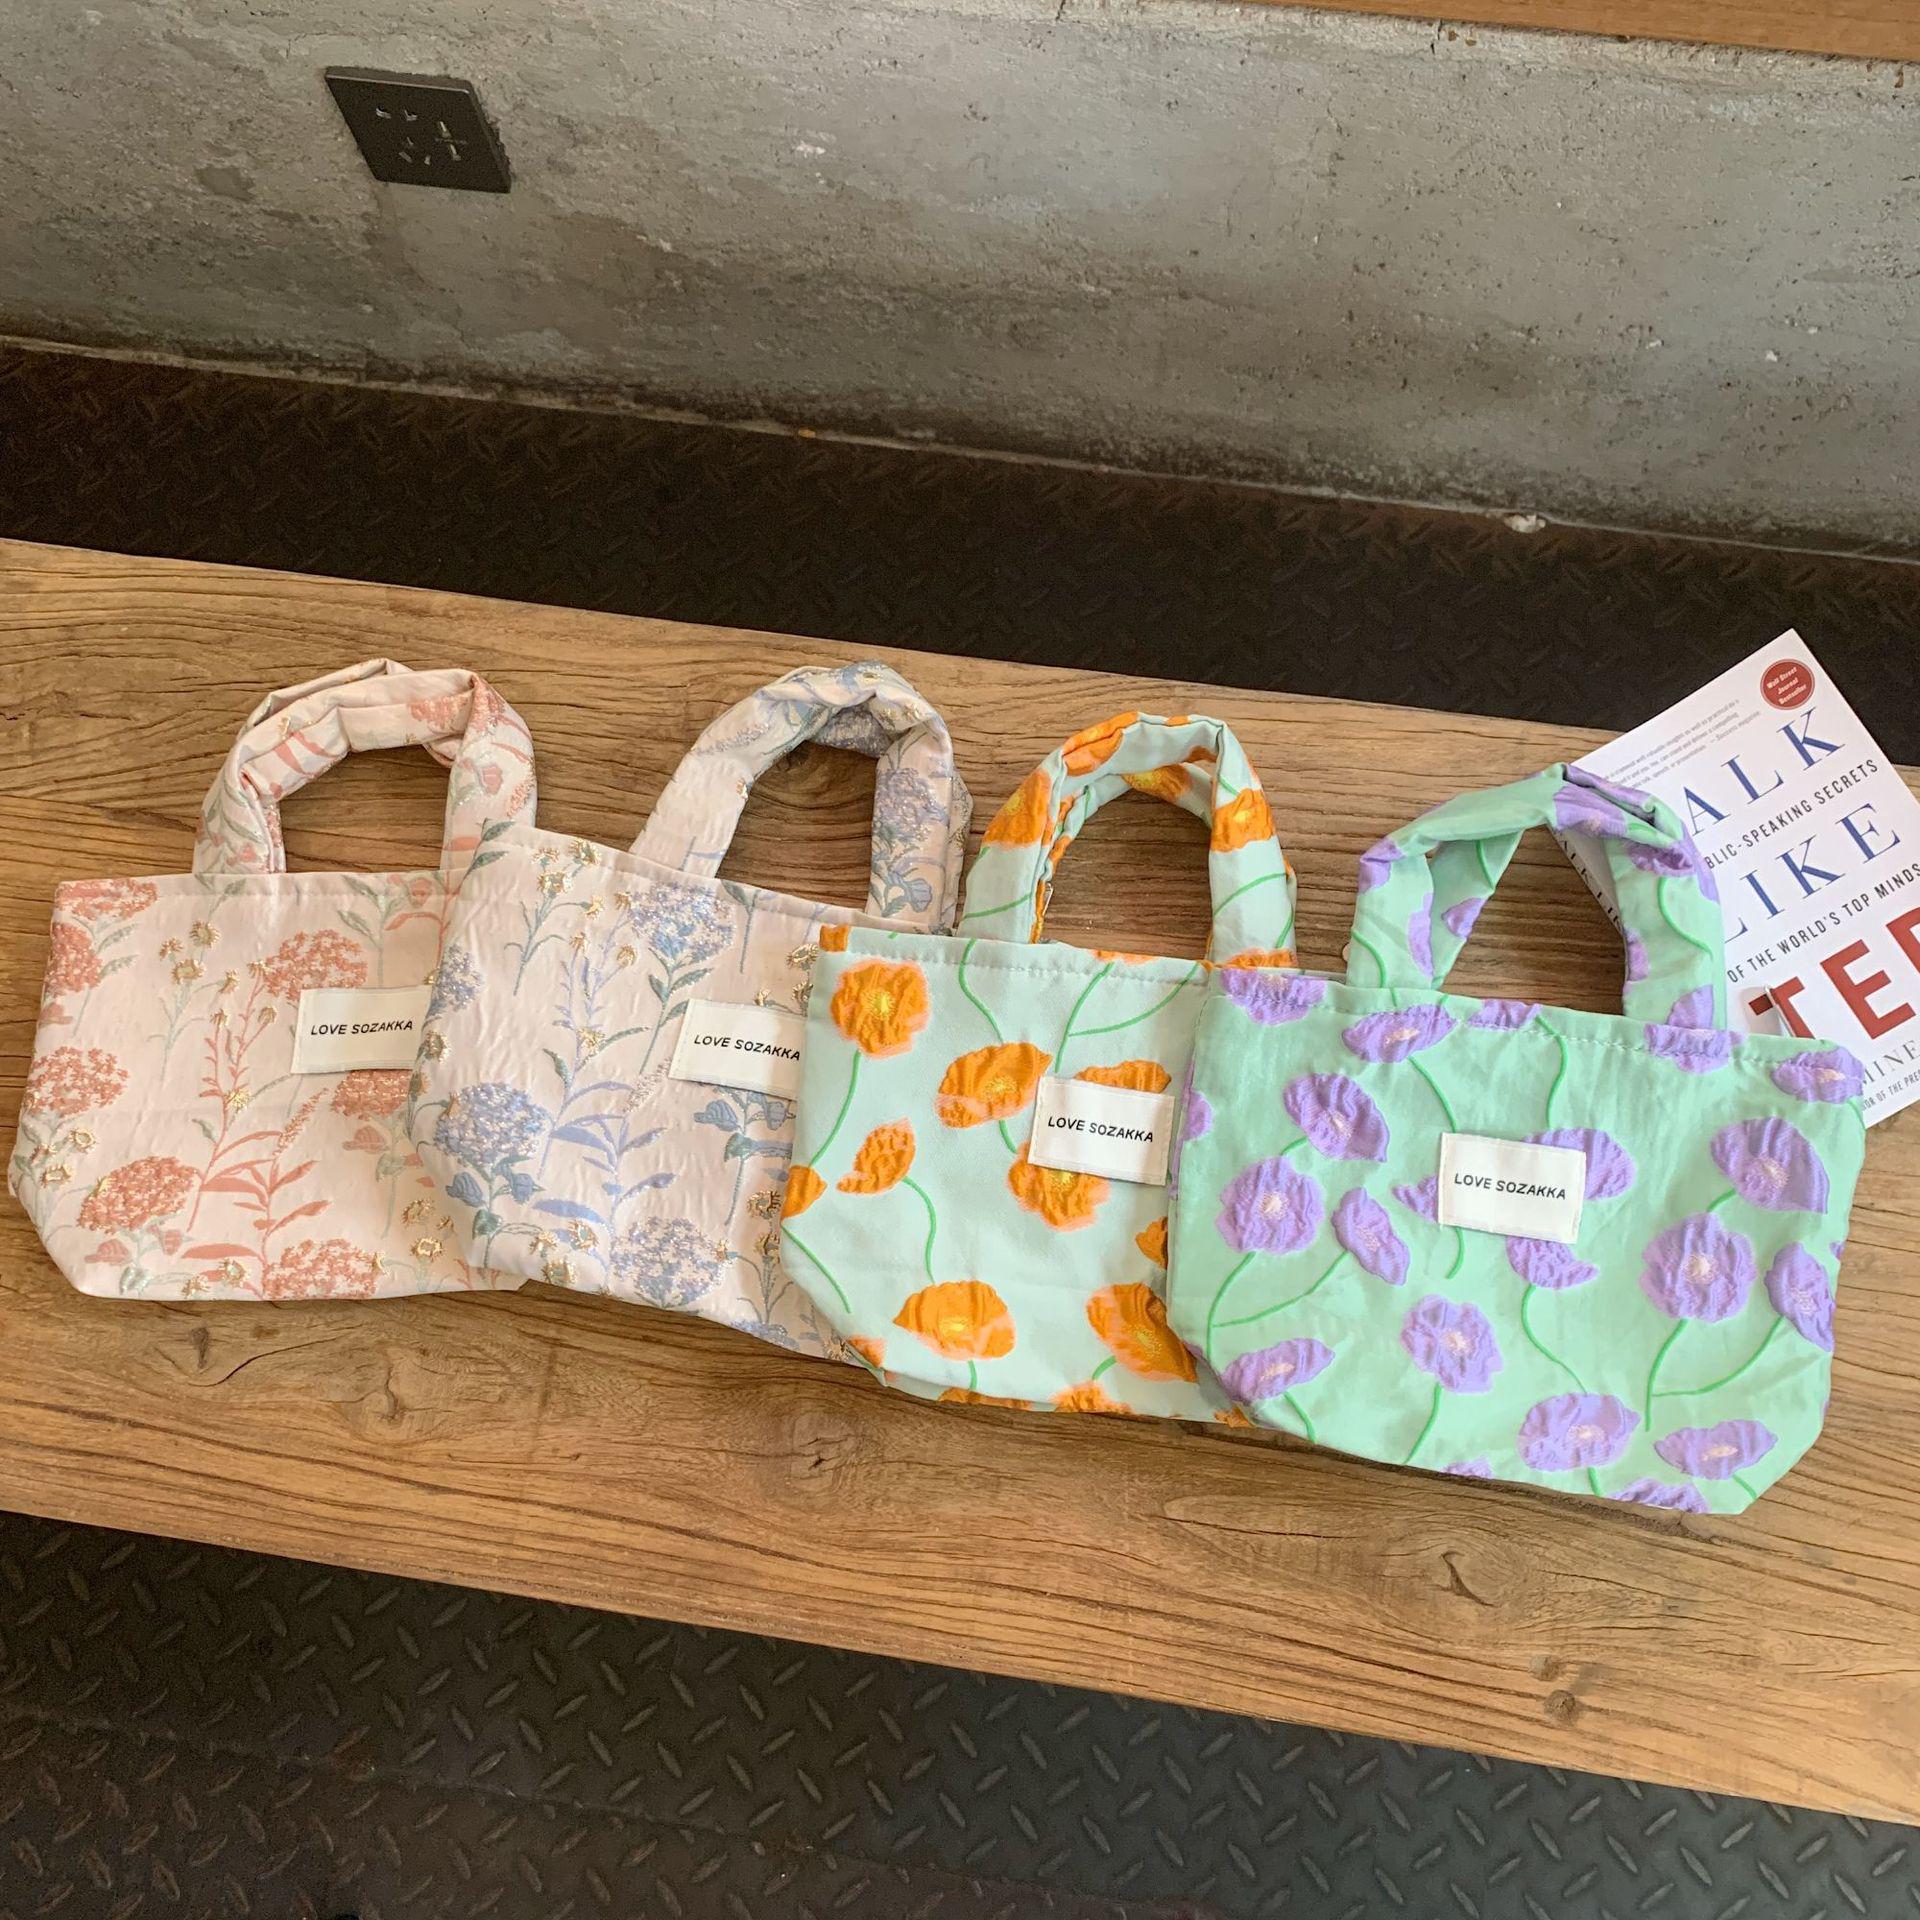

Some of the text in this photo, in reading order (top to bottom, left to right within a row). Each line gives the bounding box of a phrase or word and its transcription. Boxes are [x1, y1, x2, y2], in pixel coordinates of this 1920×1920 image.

[1683, 706, 1846, 837] ALK
[1704, 759, 1878, 870] BLIC-SPEAKING SECRETS
[1727, 863, 1920, 983] OF THE WORLD'S TOP MINDS
[310, 1020, 413, 1036] LOVE SOZAKKA
[694, 1035, 800, 1061] LOVE SOZAKKA
[1048, 1116, 1153, 1143] LOVE SOZAKKA
[1454, 1173, 1566, 1200] LOVE SOZAKKA
